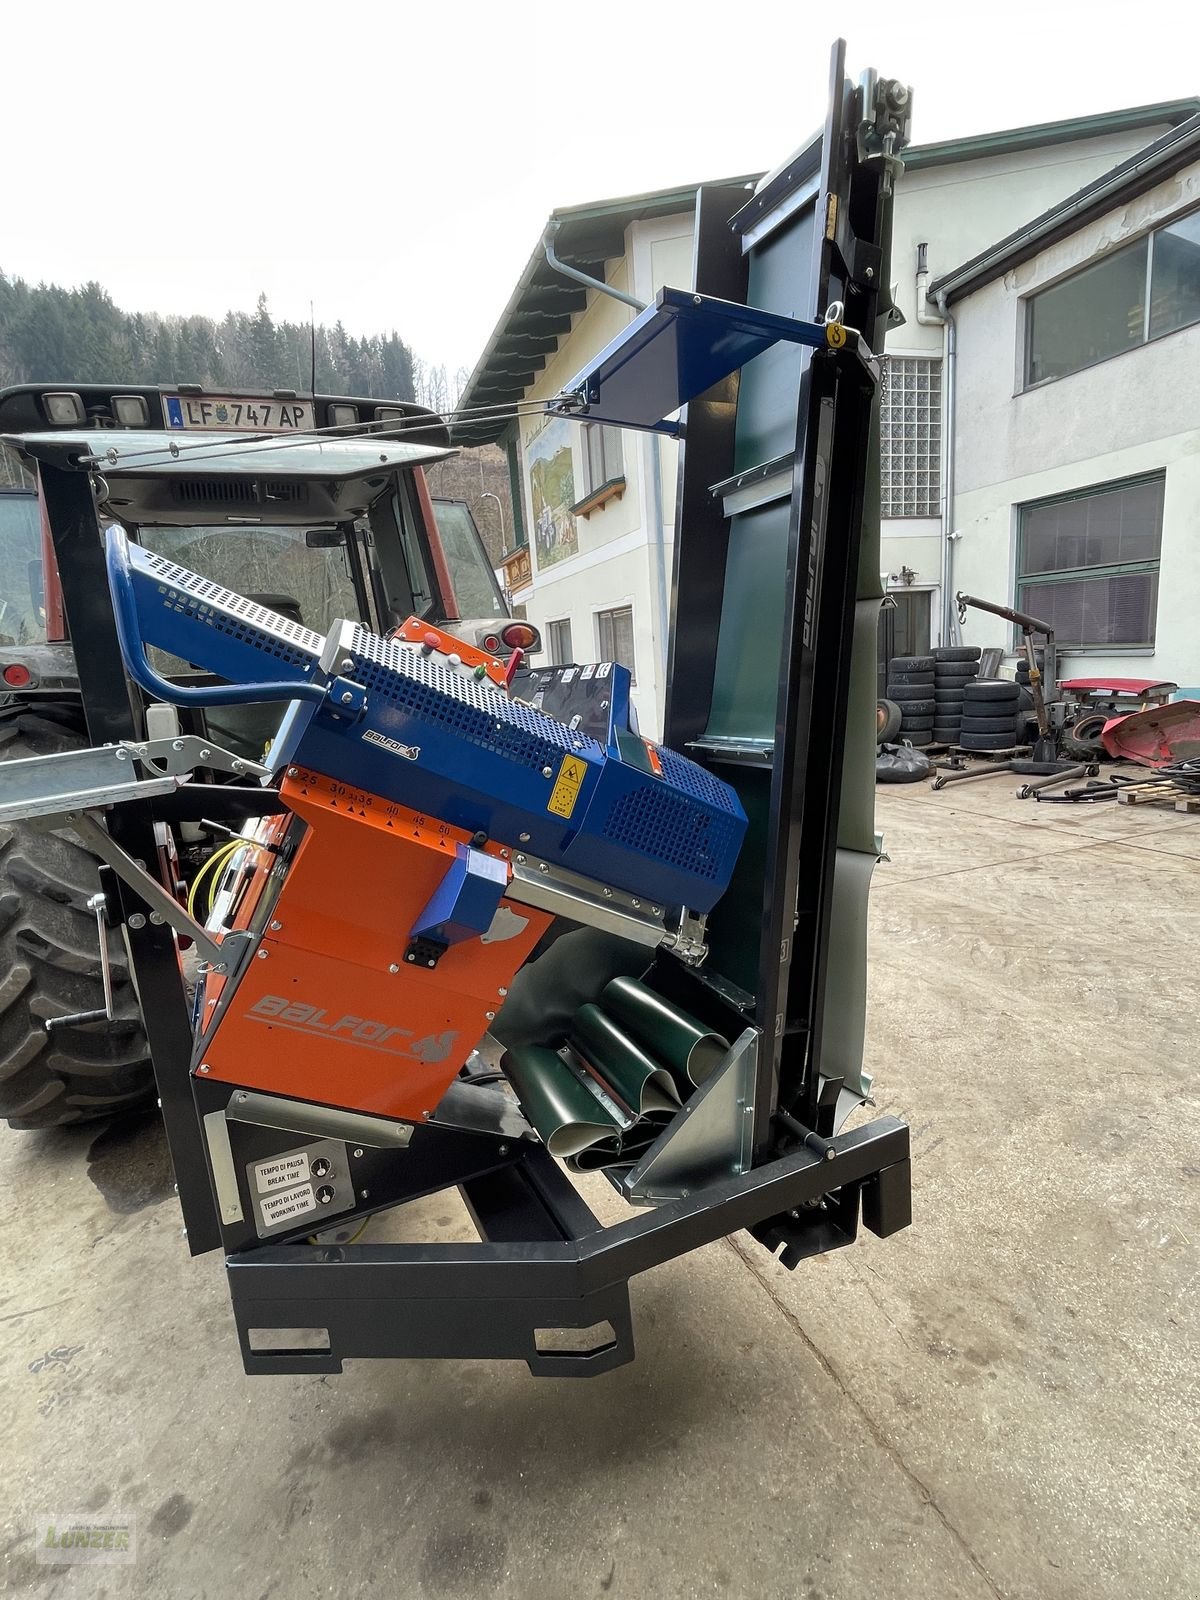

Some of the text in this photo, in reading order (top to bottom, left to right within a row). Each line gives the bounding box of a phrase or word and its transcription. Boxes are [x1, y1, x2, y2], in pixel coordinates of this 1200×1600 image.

[186, 403, 305, 427] LF 747 AP
[301, 772, 318, 786] 25
[329, 783, 346, 796] 30
[358, 794, 373, 806] 35
[386, 805, 399, 816] 40
[412, 815, 425, 826] 45
[438, 824, 450, 836] 50
[260, 1165, 280, 1177] TEMPO
[286, 1158, 305, 1169] PAUSA
[267, 1171, 300, 1186] BREAK TIME
[263, 1188, 311, 1211] TEMPO DI LAVORO
[270, 1200, 310, 1220] WORKING TIME
